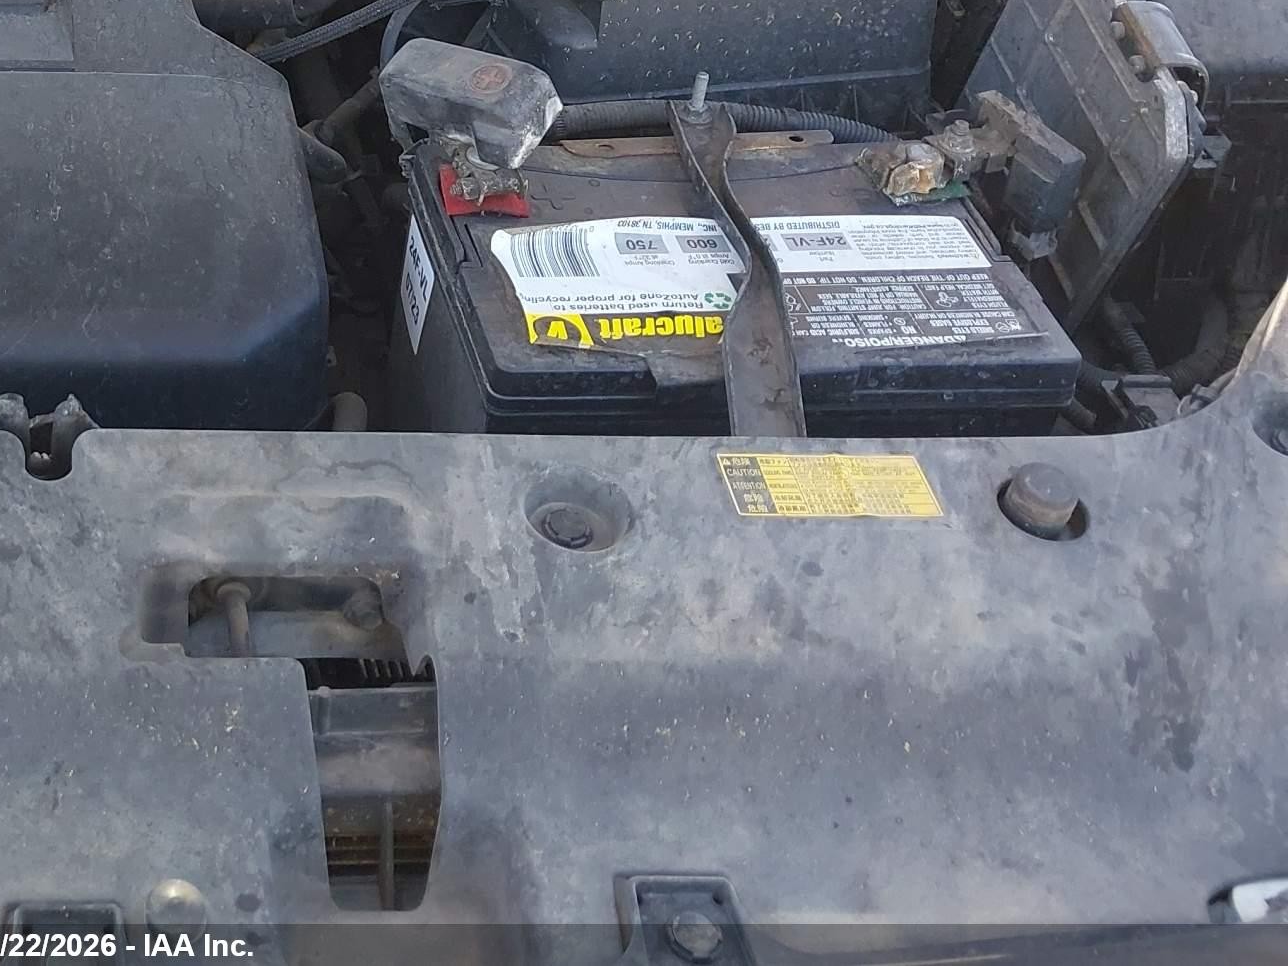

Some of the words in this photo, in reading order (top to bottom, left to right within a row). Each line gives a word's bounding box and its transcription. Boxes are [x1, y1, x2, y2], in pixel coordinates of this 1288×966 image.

[642, 220, 652, 229] TN
[656, 220, 694, 232] MEMPHIS,
[774, 222, 784, 230] BY
[787, 220, 840, 230] DISTRIBUTED
[626, 240, 657, 250] 750
[688, 239, 717, 249] 600
[784, 236, 846, 247] 24F-VL
[576, 293, 615, 302] proper
[618, 294, 636, 302] for
[639, 293, 698, 301] AutoZone
[570, 303, 624, 311] batteries
[628, 302, 658, 310] used
[662, 301, 704, 310] Return
[599, 314, 723, 340] alucraft
[901, 326, 917, 334] NO
[831, 335, 956, 347] DANGER/POISO
